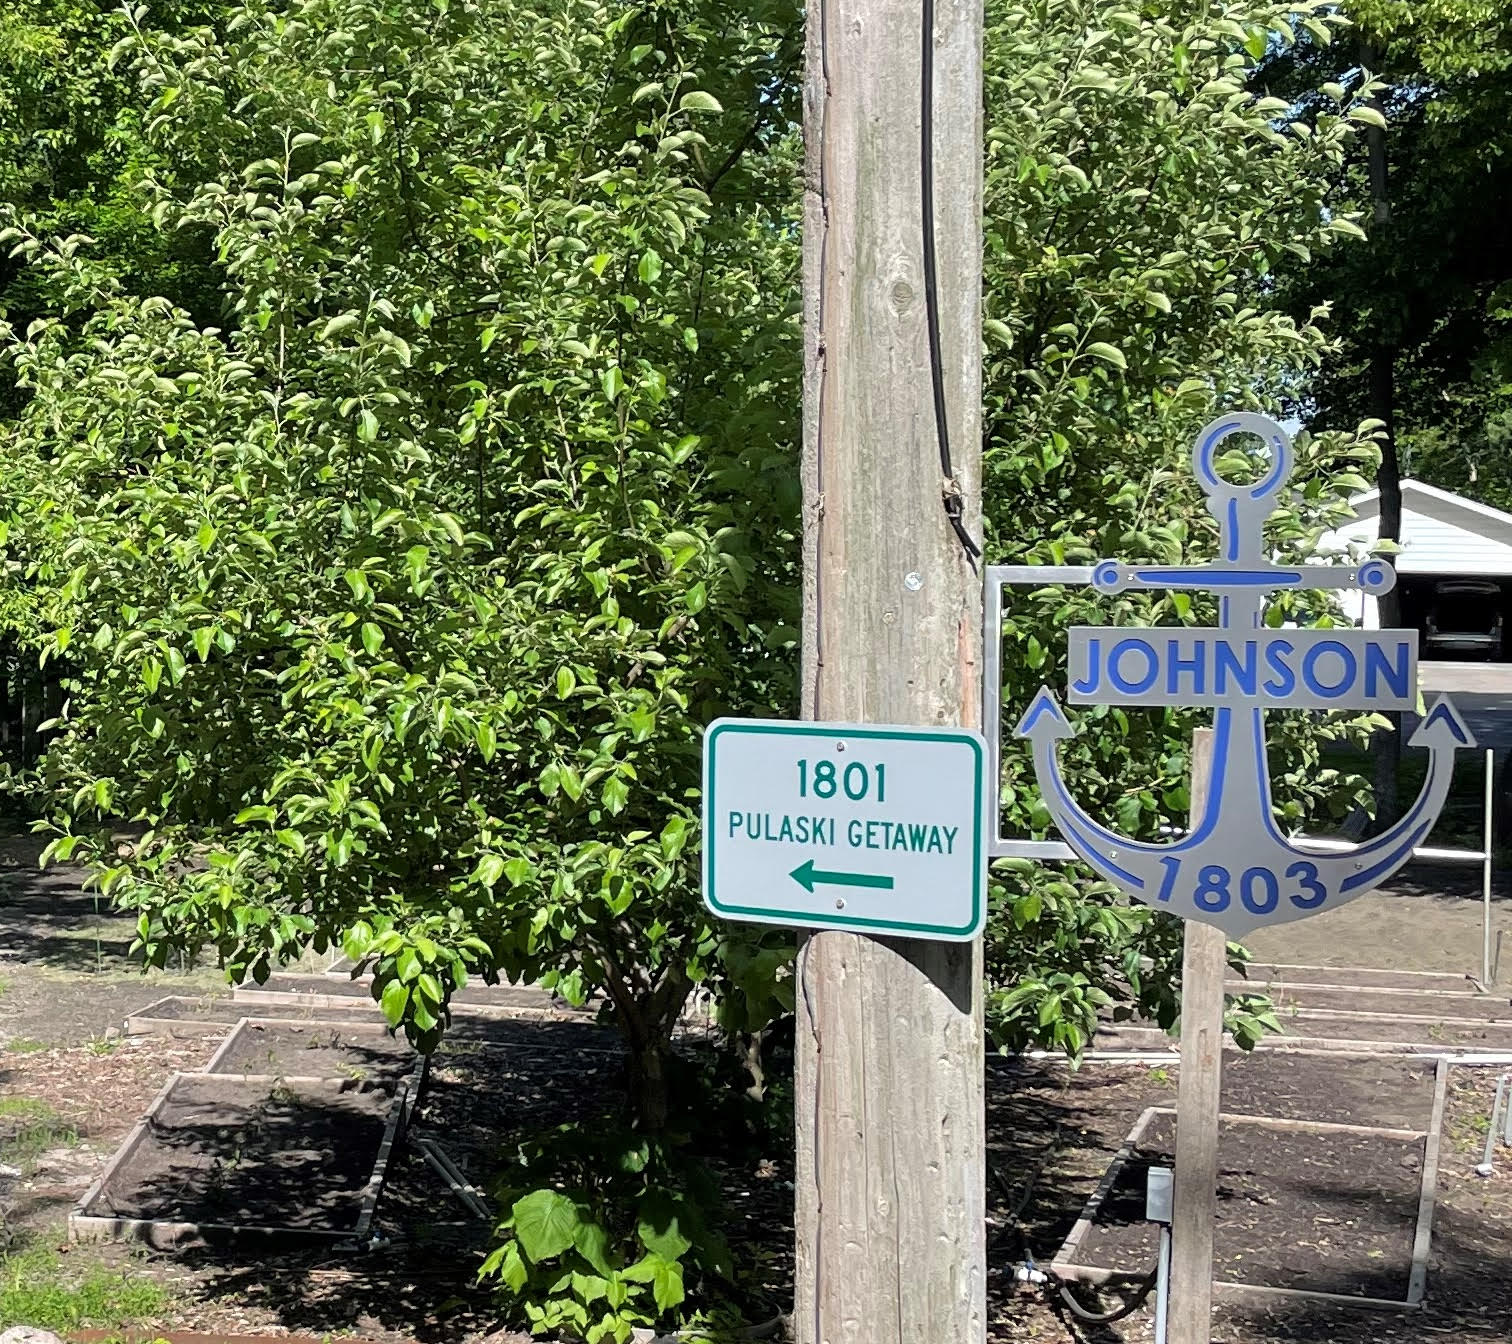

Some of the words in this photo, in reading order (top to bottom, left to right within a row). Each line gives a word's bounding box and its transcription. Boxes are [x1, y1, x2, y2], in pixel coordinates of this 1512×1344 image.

[1072, 639, 1409, 698] JOHNSON
[797, 759, 885, 802] 1801
[729, 811, 835, 846] PULASKI
[848, 820, 958, 854] GETAWAY
[1158, 856, 1327, 915] 1803
